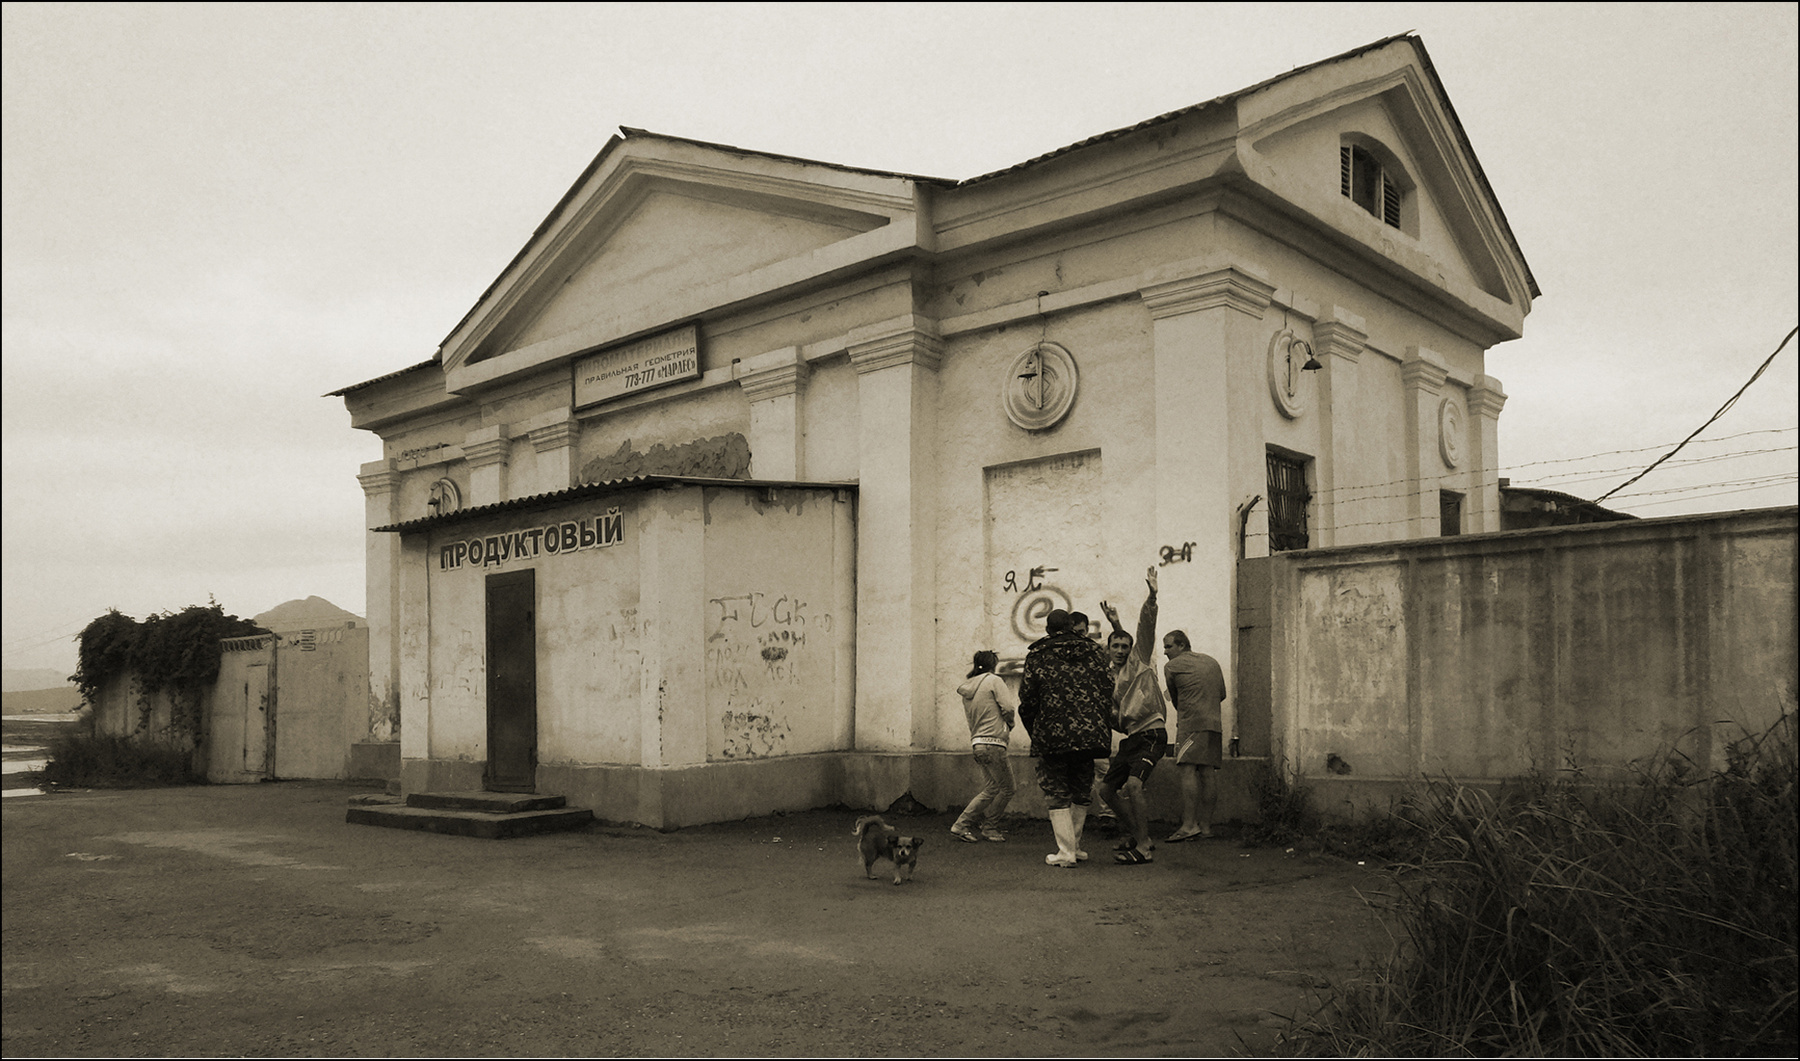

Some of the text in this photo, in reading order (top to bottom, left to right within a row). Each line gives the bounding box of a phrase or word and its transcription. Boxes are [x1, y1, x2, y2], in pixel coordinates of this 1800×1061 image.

[584, 346, 696, 385] ПРАВИЛЬНАЯ ГЕОМЕТРИЯ
[625, 367, 656, 389] 773-777
[440, 507, 624, 571] ПРОДУКТОВЫЙ
